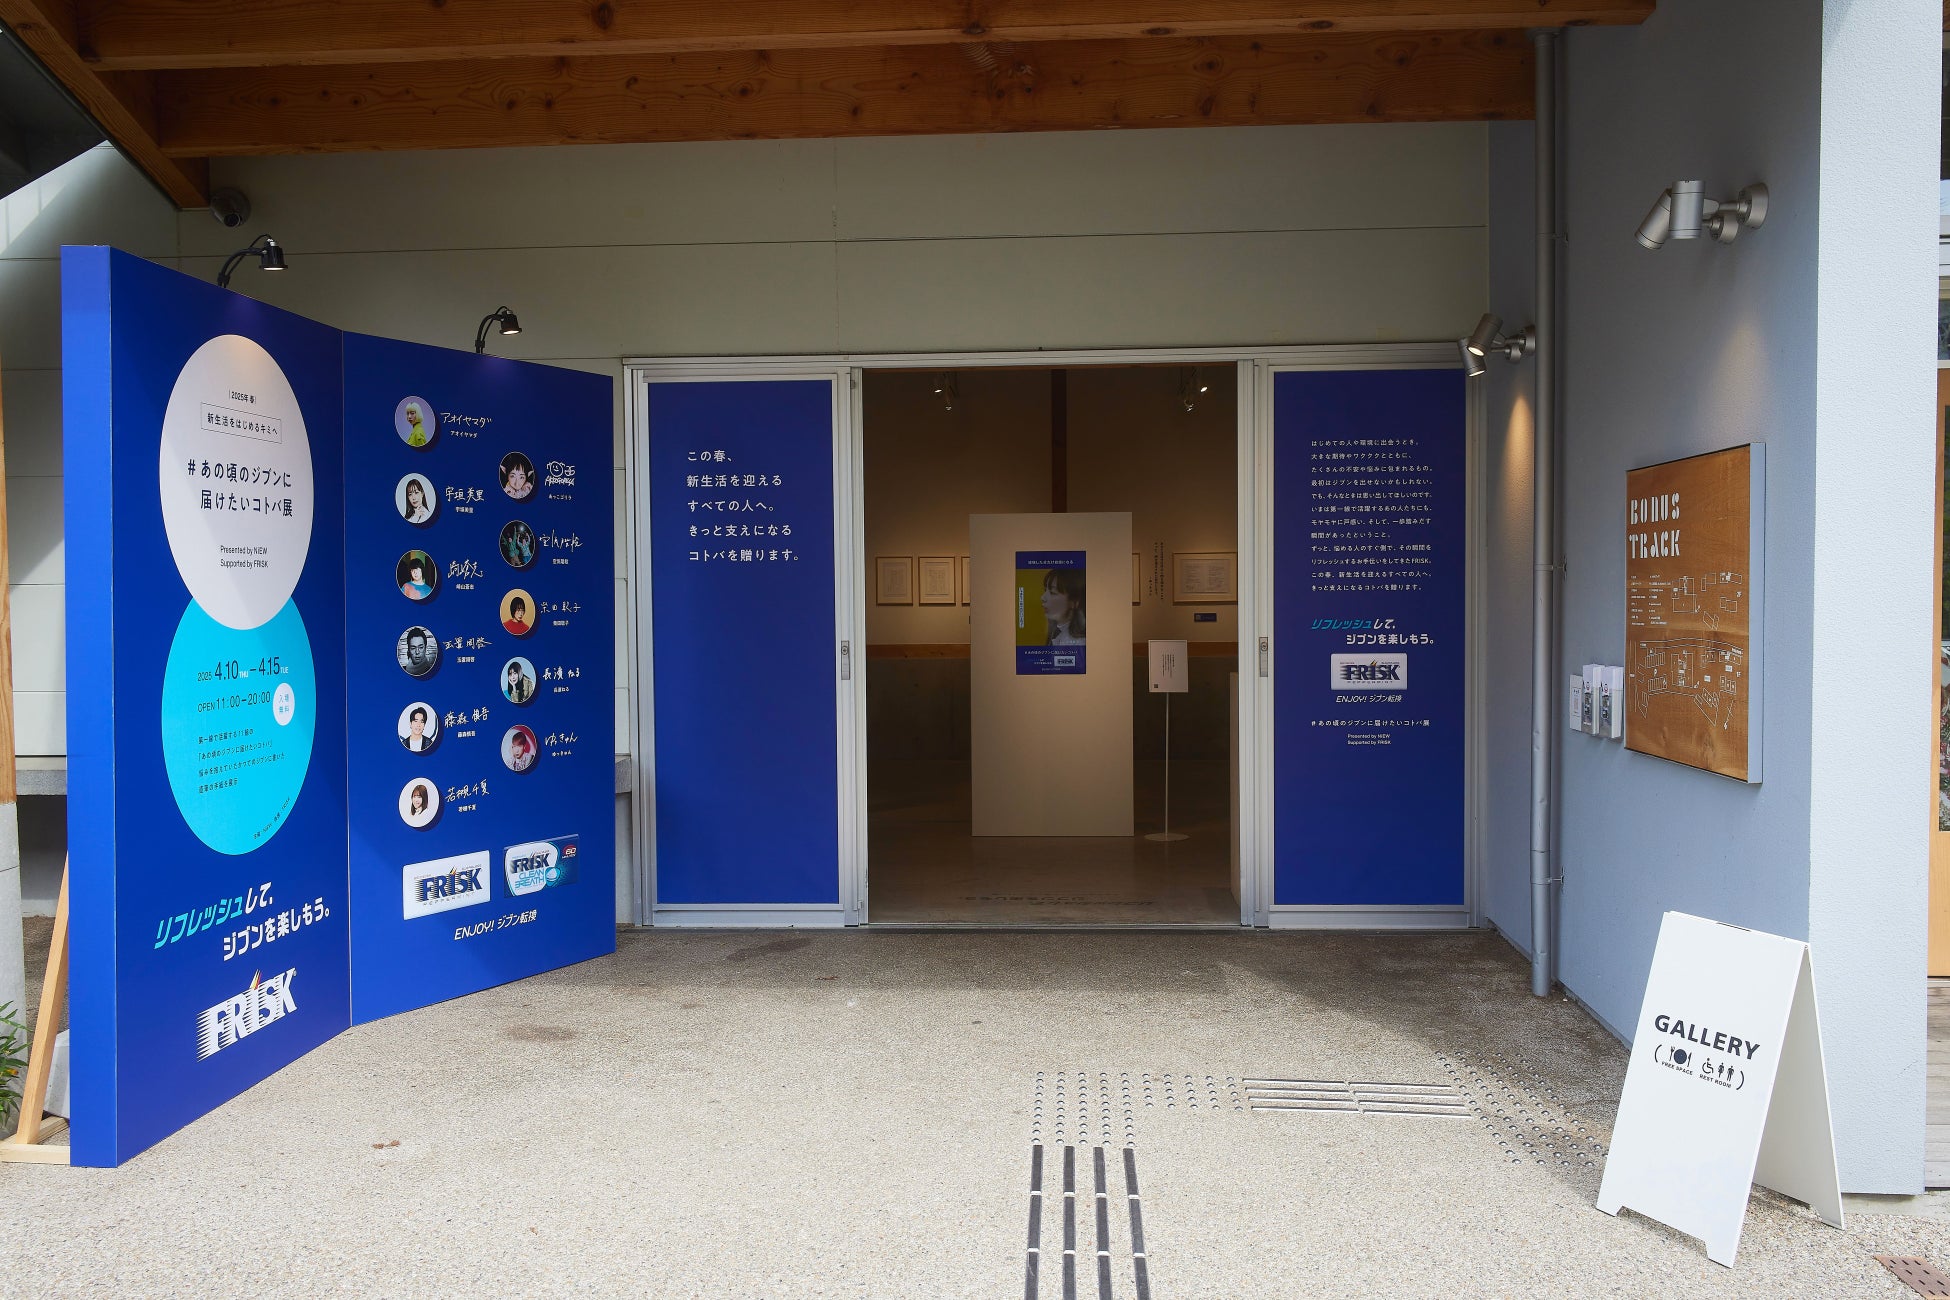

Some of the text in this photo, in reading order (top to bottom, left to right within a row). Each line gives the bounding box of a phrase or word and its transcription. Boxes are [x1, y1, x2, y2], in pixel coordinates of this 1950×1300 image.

[207, 412, 278, 435] 新生活をはじめるキミへ
[440, 412, 492, 428] アオイヤマダ
[688, 450, 732, 462] この春、
[686, 475, 782, 488] 新生活を迎える
[200, 490, 293, 518] 届けたいコトバ展
[688, 500, 774, 512] すべての人へ。
[1630, 492, 1680, 525] BONUS
[689, 524, 792, 537] きっと支えになる
[220, 545, 245, 555] Presented
[246, 547, 253, 556] by
[1629, 529, 1680, 559] TRACK
[689, 549, 799, 562] コトバを贈ります。
[220, 558, 268, 569] Supported by FRISK
[1311, 619, 1396, 630] リフレッシュして、
[1346, 634, 1434, 645] ジブンを楽しもう。
[198, 672, 212, 681] 2025
[215, 660, 238, 680] 4.10
[259, 657, 280, 675] 4.15
[1340, 660, 1400, 680] FRISK
[1336, 695, 1367, 703] ENJOY!
[198, 702, 214, 712] OPEN
[510, 853, 550, 874] FRISK
[519, 869, 544, 879] CLEAN
[414, 867, 483, 903] FRISK
[515, 877, 545, 888] BREATH
[154, 882, 273, 949] リフレッシュして、
[224, 897, 330, 961] ジブンを楽しもう。
[454, 909, 537, 941] ENJOY! ジブン転換
[196, 967, 298, 1063] FRISK
[1654, 1014, 1760, 1060] GALLERY
[1660, 1061, 1693, 1076] FREE SPACE
[1699, 1074, 1731, 1088] REST ROOM
